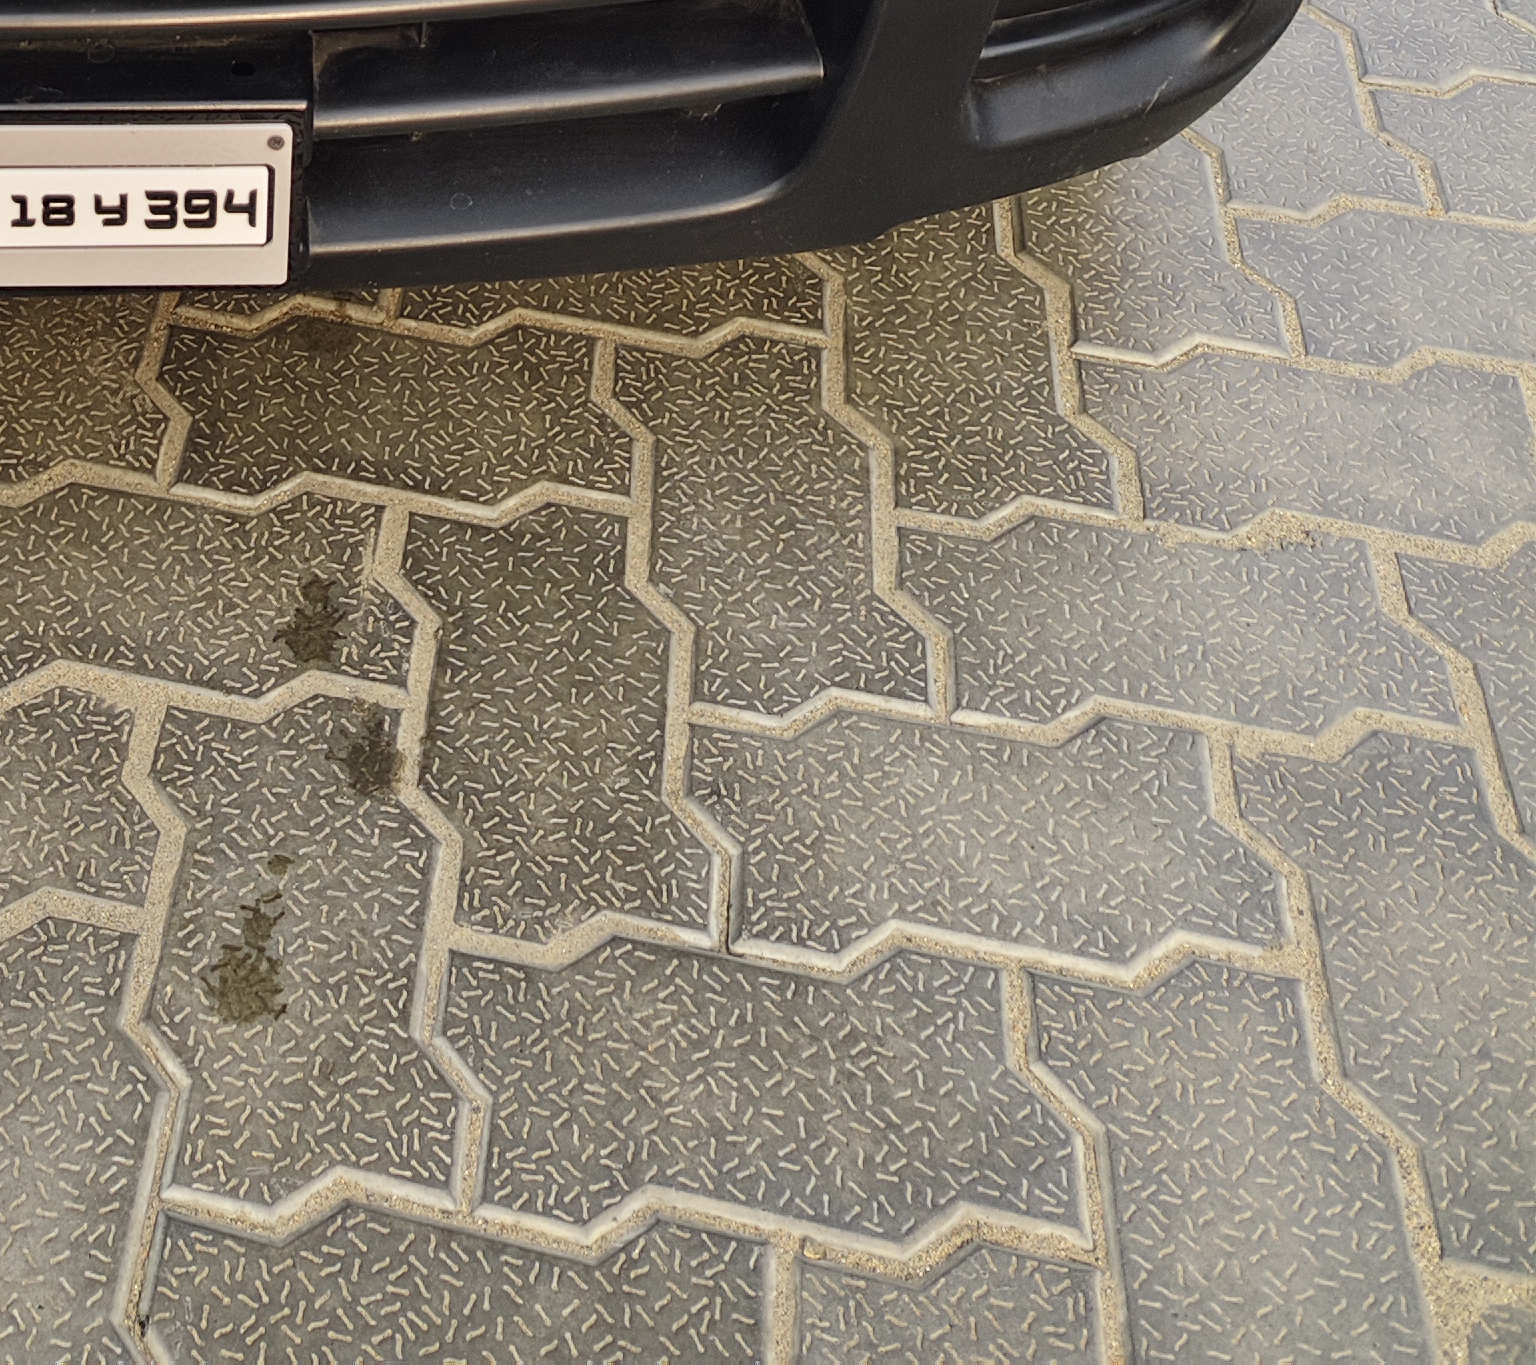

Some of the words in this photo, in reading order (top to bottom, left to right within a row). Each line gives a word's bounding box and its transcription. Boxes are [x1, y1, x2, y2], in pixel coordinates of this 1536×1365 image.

[10, 193, 77, 228] 18
[93, 192, 129, 226] Y
[144, 189, 259, 231] 394
